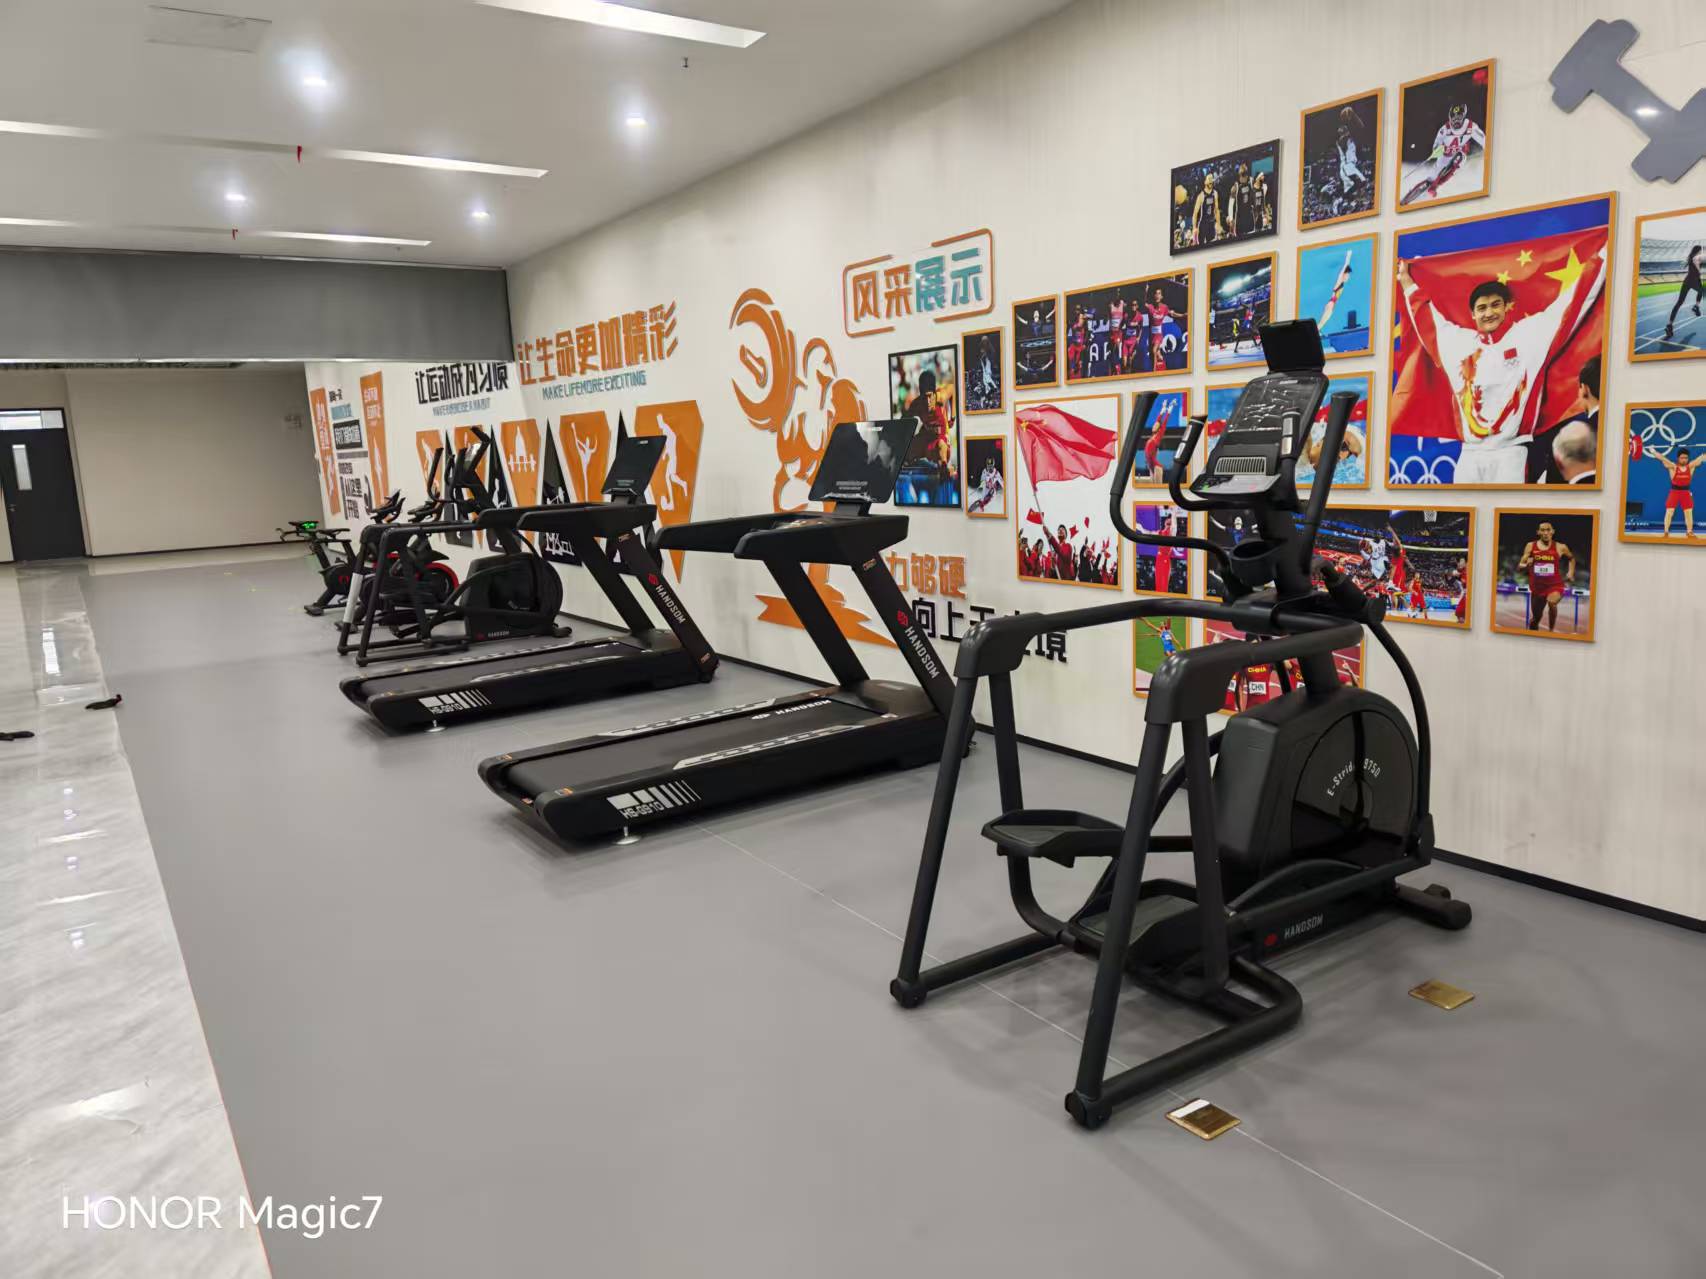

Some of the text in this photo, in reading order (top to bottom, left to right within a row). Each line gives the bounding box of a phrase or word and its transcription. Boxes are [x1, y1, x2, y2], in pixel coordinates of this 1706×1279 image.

[852, 247, 983, 323] 风采展示
[655, 584, 687, 625] HANDSOM
[904, 625, 941, 681] HANDSOM
[1251, 682, 1265, 692] CHN
[1326, 760, 1356, 798] E-Strid
[1283, 913, 1324, 940] HANDSOM
